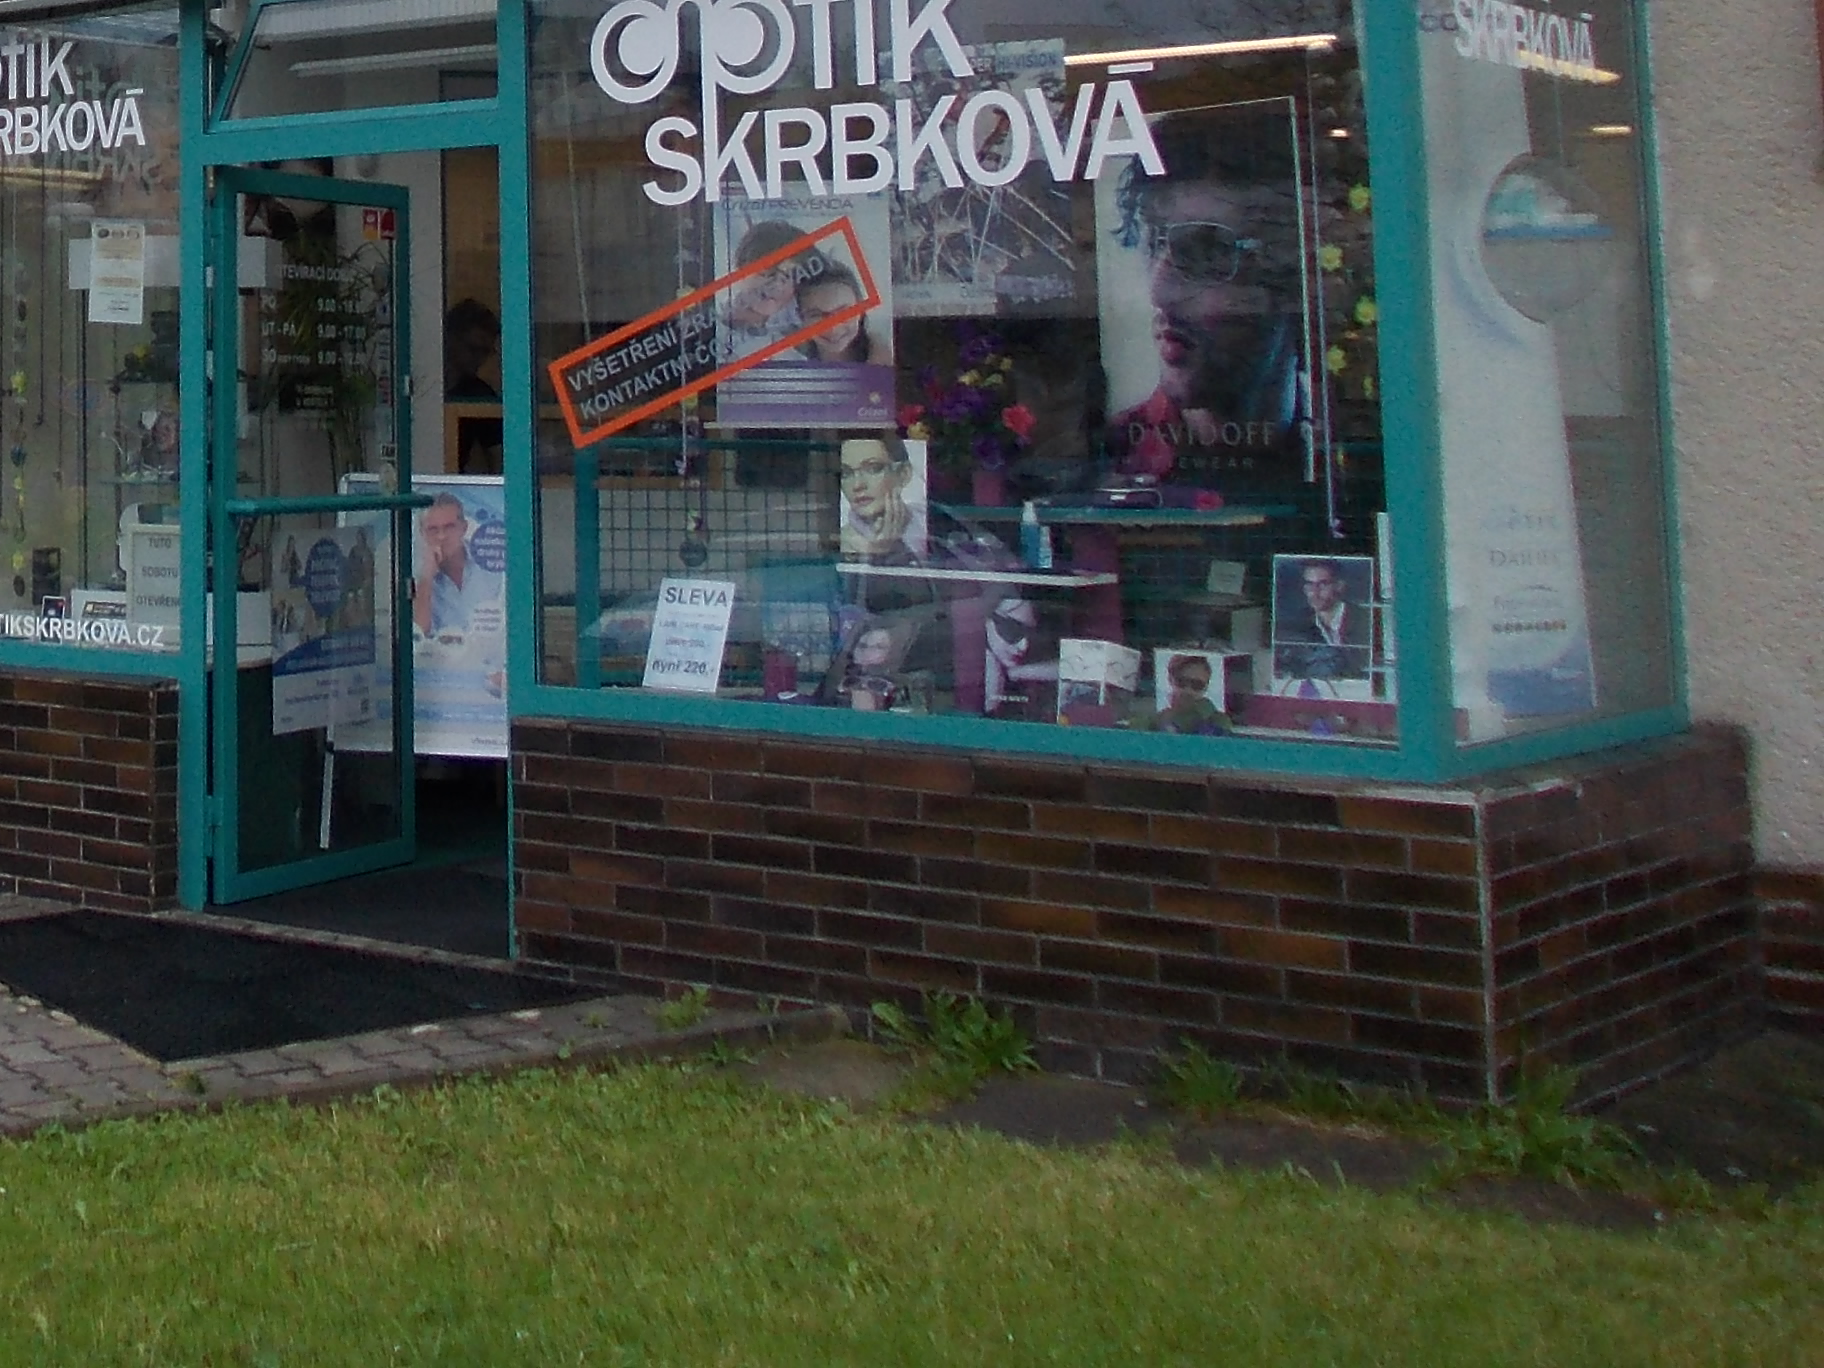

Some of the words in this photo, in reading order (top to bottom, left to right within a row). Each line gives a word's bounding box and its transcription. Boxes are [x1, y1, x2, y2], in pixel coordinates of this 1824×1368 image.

[567, 322, 677, 392] VYŠETŘENÍ
[136, 594, 180, 608] OTEVŘEN
[664, 586, 728, 608] SLEVA
